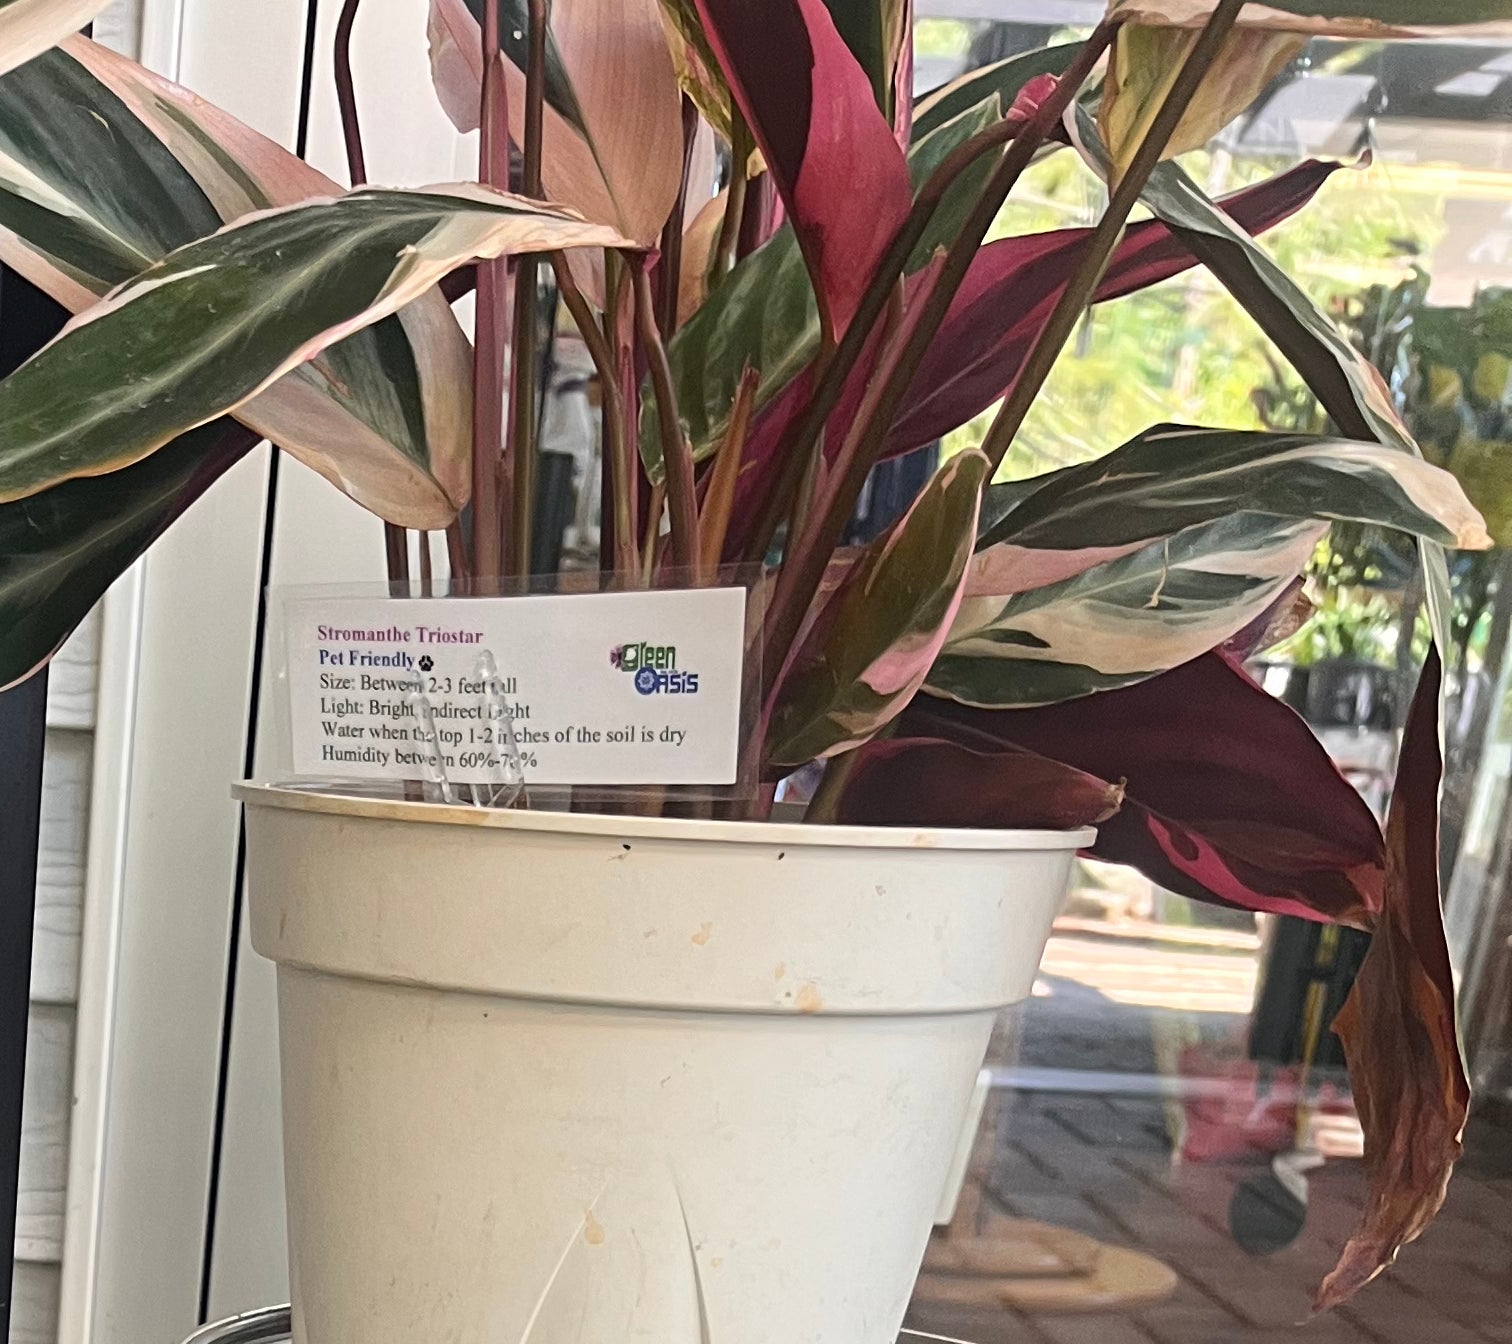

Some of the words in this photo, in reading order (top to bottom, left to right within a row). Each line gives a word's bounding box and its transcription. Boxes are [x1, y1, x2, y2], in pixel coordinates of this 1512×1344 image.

[317, 625, 411, 642] Stromanthe
[416, 626, 484, 644] Triostar
[319, 649, 344, 665] Pet
[349, 650, 415, 671] Friendly
[320, 673, 355, 690] Size:
[361, 674, 423, 693] Between
[428, 677, 452, 693] 2-3
[458, 678, 486, 694] feet
[321, 698, 364, 717] Light:
[423, 702, 481, 719] ndirect
[322, 721, 365, 738] Water
[370, 723, 408, 740] when
[439, 728, 463, 747] top
[469, 727, 493, 743] 1-2
[554, 726, 574, 743] of
[577, 726, 601, 743] the
[606, 725, 635, 743] soil
[641, 725, 654, 742] is
[659, 725, 686, 746] dry
[322, 745, 389, 767] Humidity
[395, 748, 454, 767] betwen
